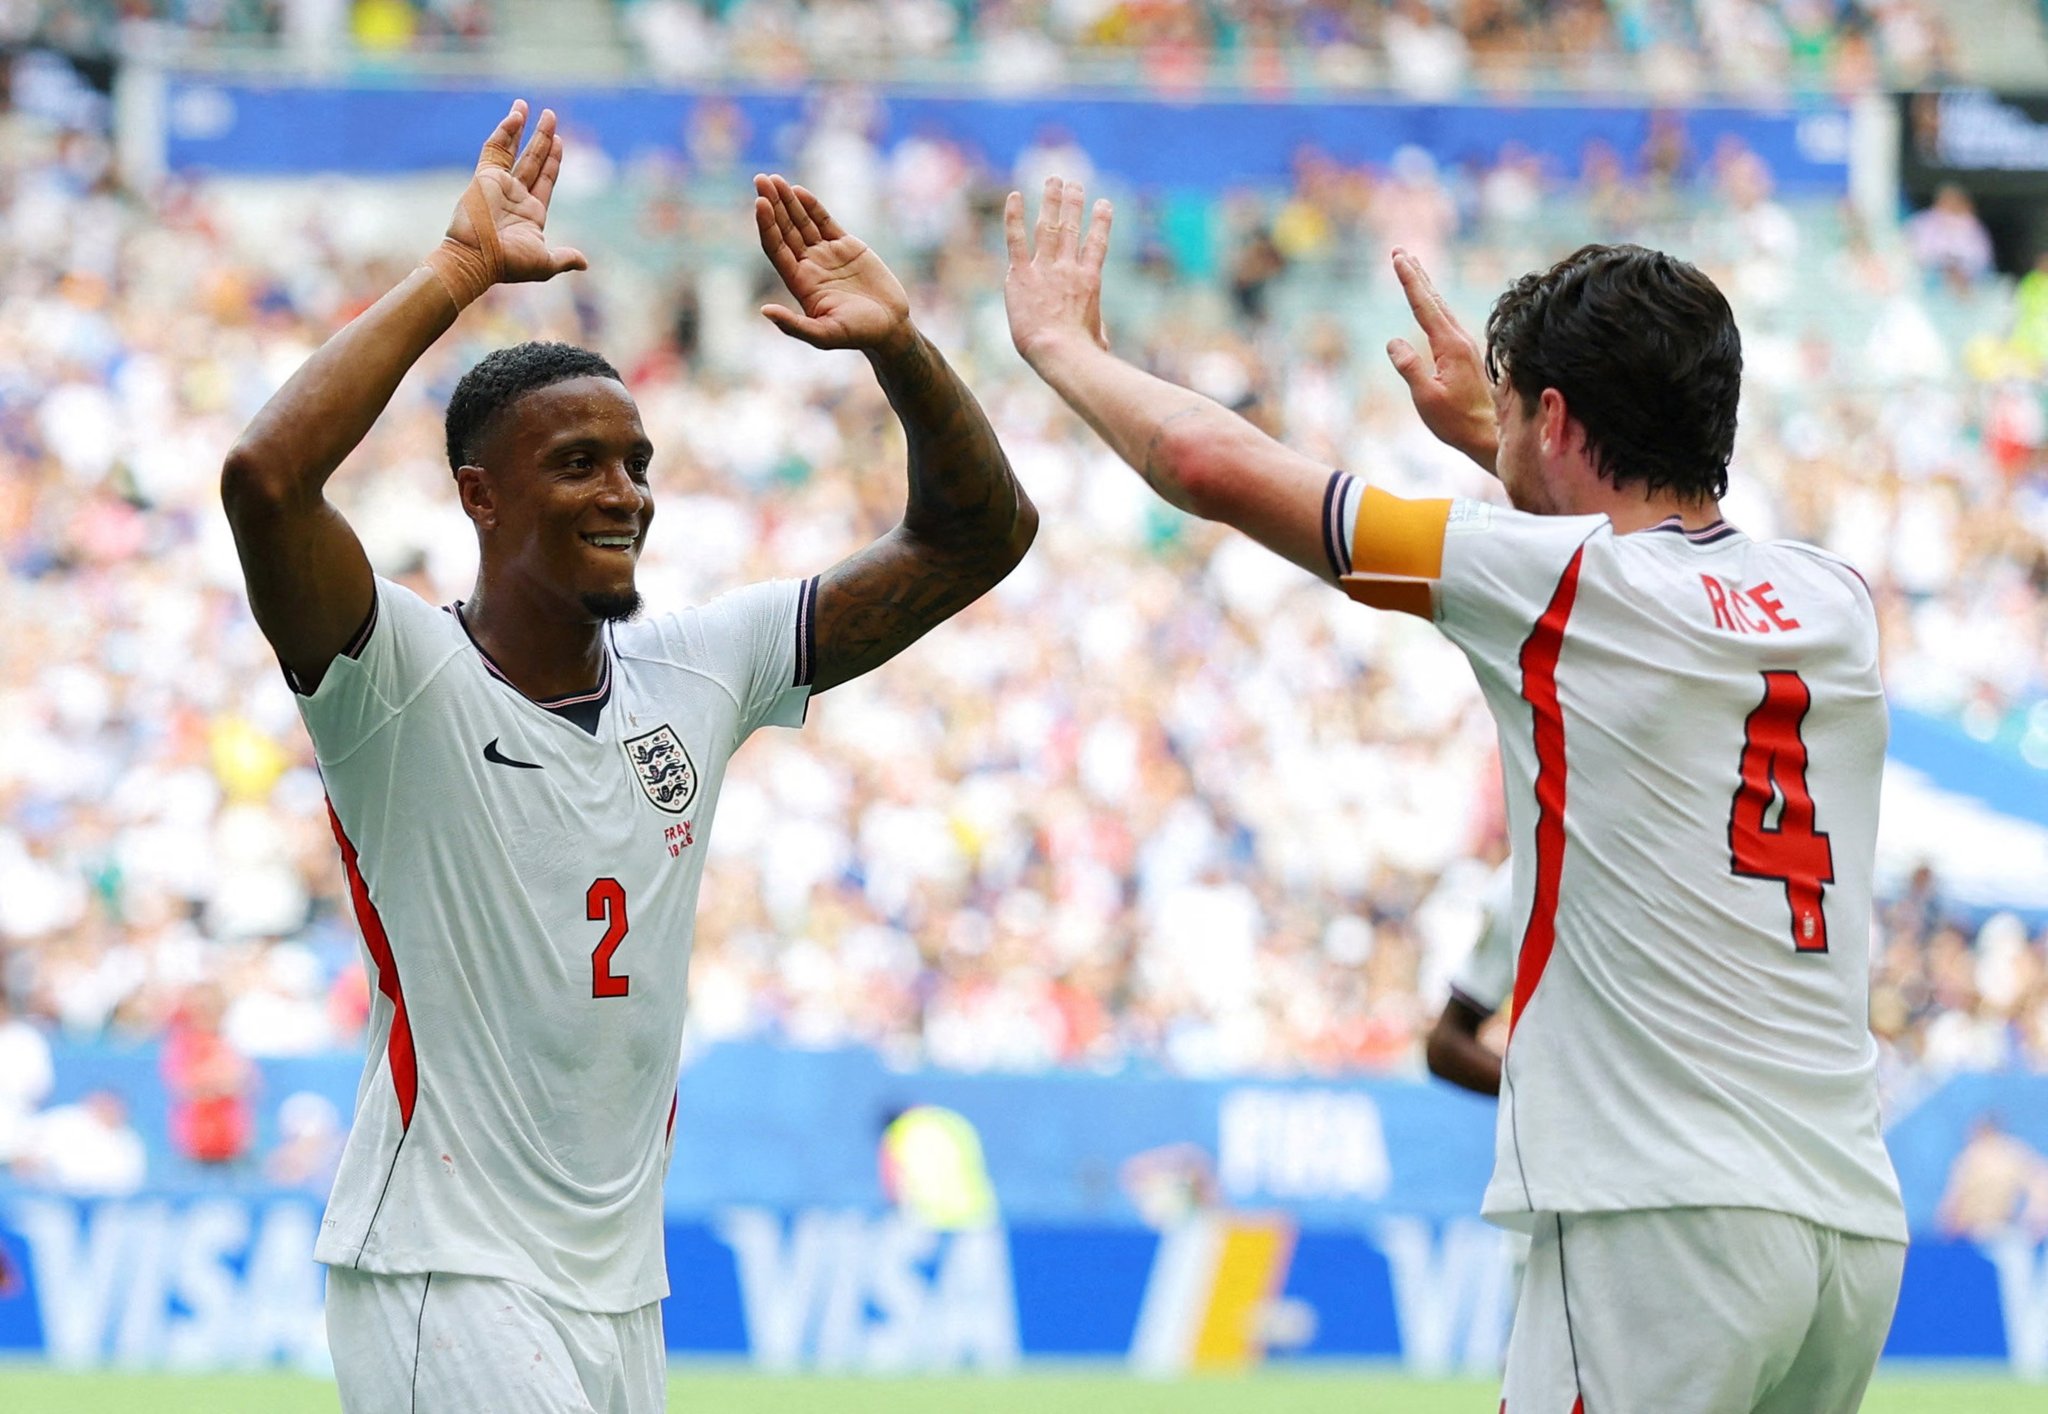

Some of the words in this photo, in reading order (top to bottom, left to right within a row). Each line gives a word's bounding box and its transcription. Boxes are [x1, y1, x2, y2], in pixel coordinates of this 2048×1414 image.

[664, 820, 693, 842] FRAN
[1728, 670, 1835, 953] 4
[586, 878, 629, 998] 2
[22, 1200, 333, 1370] VISA
[706, 1207, 1023, 1373] VISA
